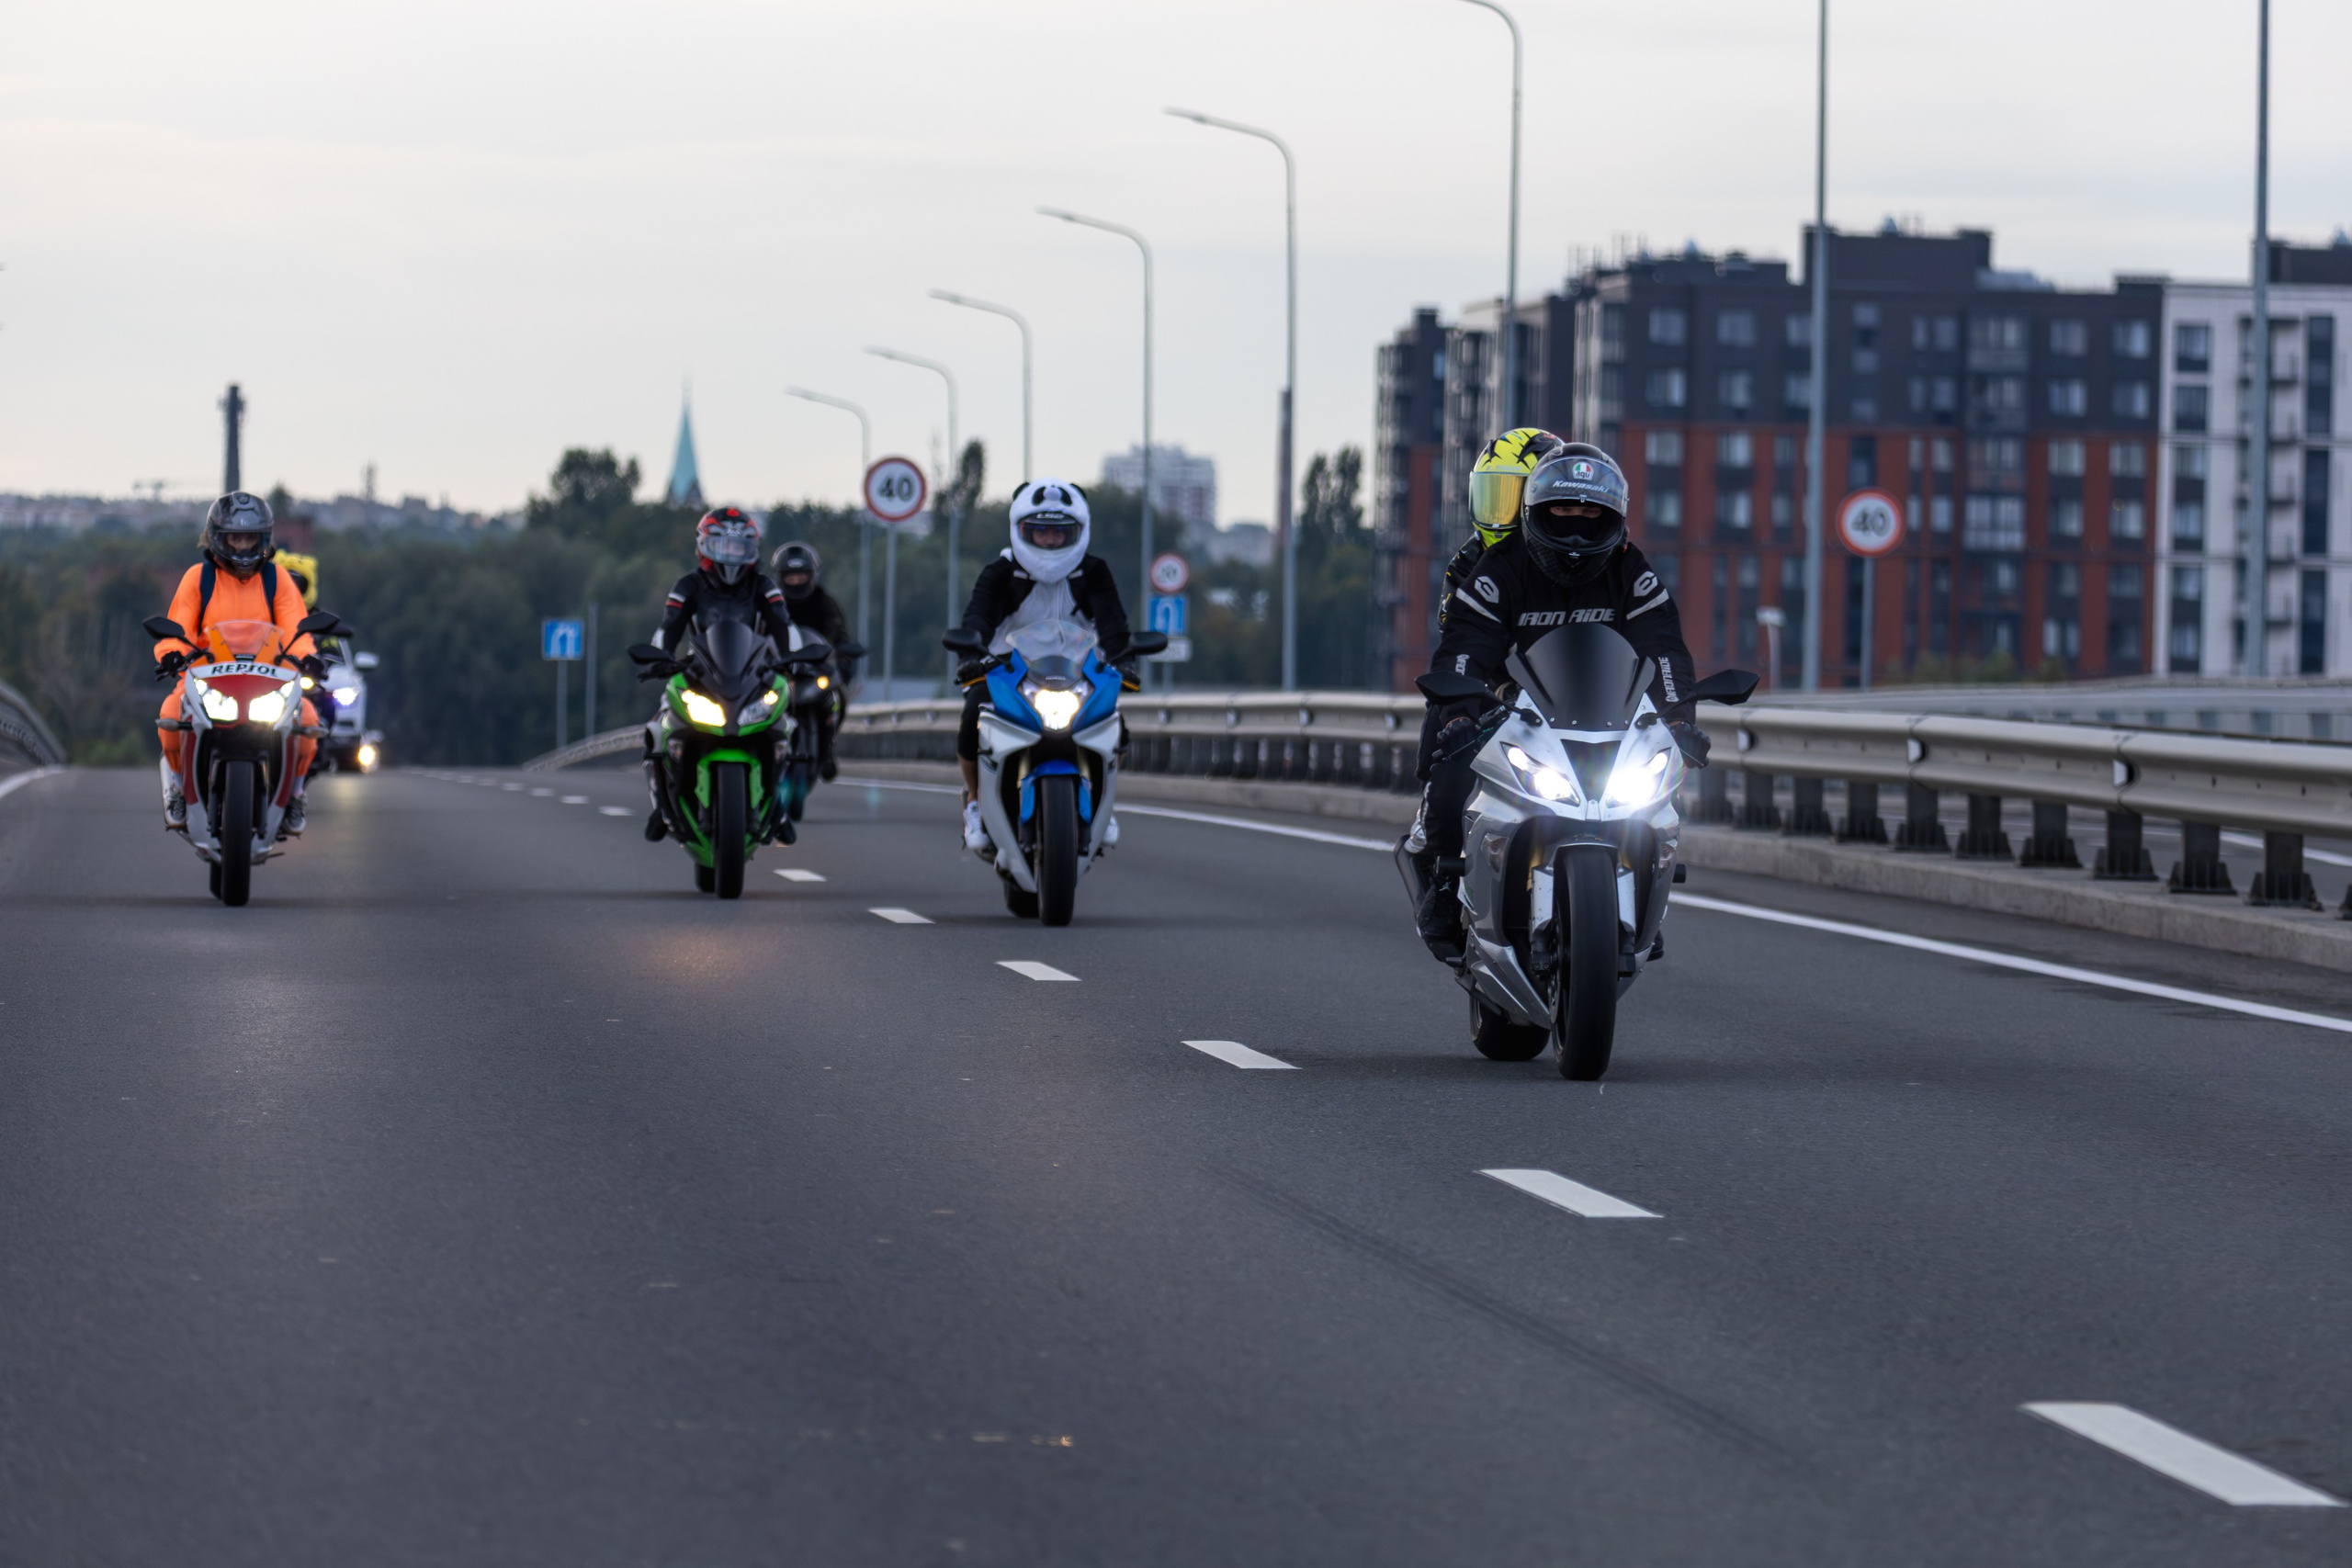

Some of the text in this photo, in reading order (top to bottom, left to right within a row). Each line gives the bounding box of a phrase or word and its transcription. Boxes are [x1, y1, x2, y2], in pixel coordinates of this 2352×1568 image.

[878, 474, 914, 502] 40
[1553, 479, 1610, 493] Kawasaki
[1851, 507, 1891, 537] 40
[1518, 611, 1566, 626] IRON
[210, 663, 278, 678] REPSOL
